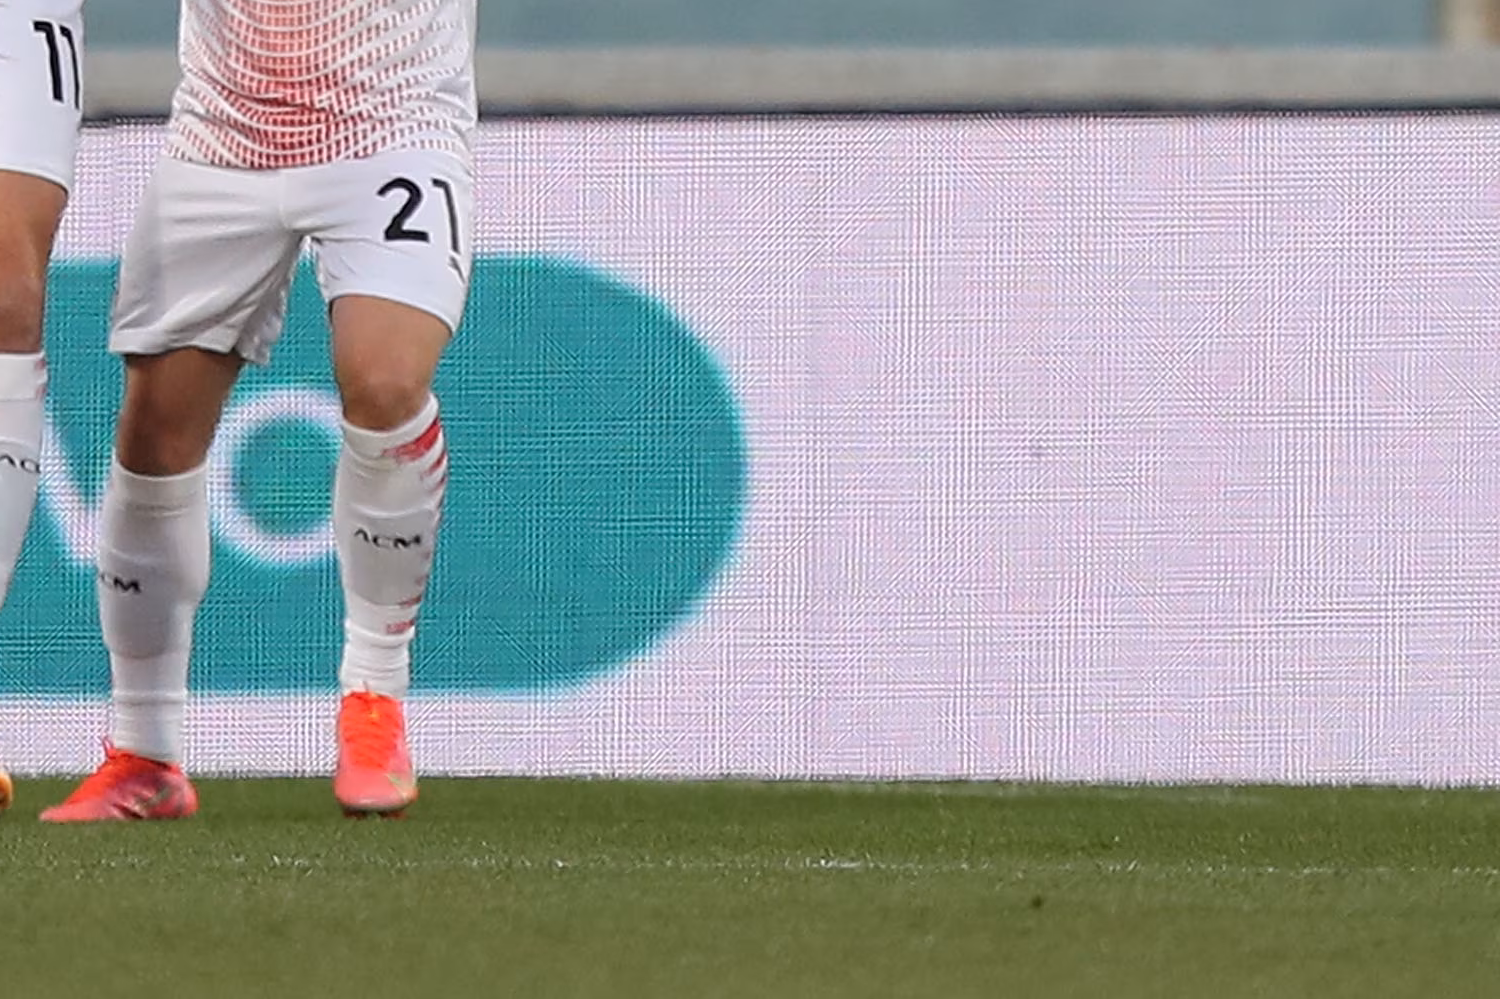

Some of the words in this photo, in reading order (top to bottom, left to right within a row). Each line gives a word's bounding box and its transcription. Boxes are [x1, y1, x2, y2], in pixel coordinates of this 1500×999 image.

[33, 20, 79, 110] 11
[376, 177, 461, 255] 21
[354, 527, 421, 550] ACM
